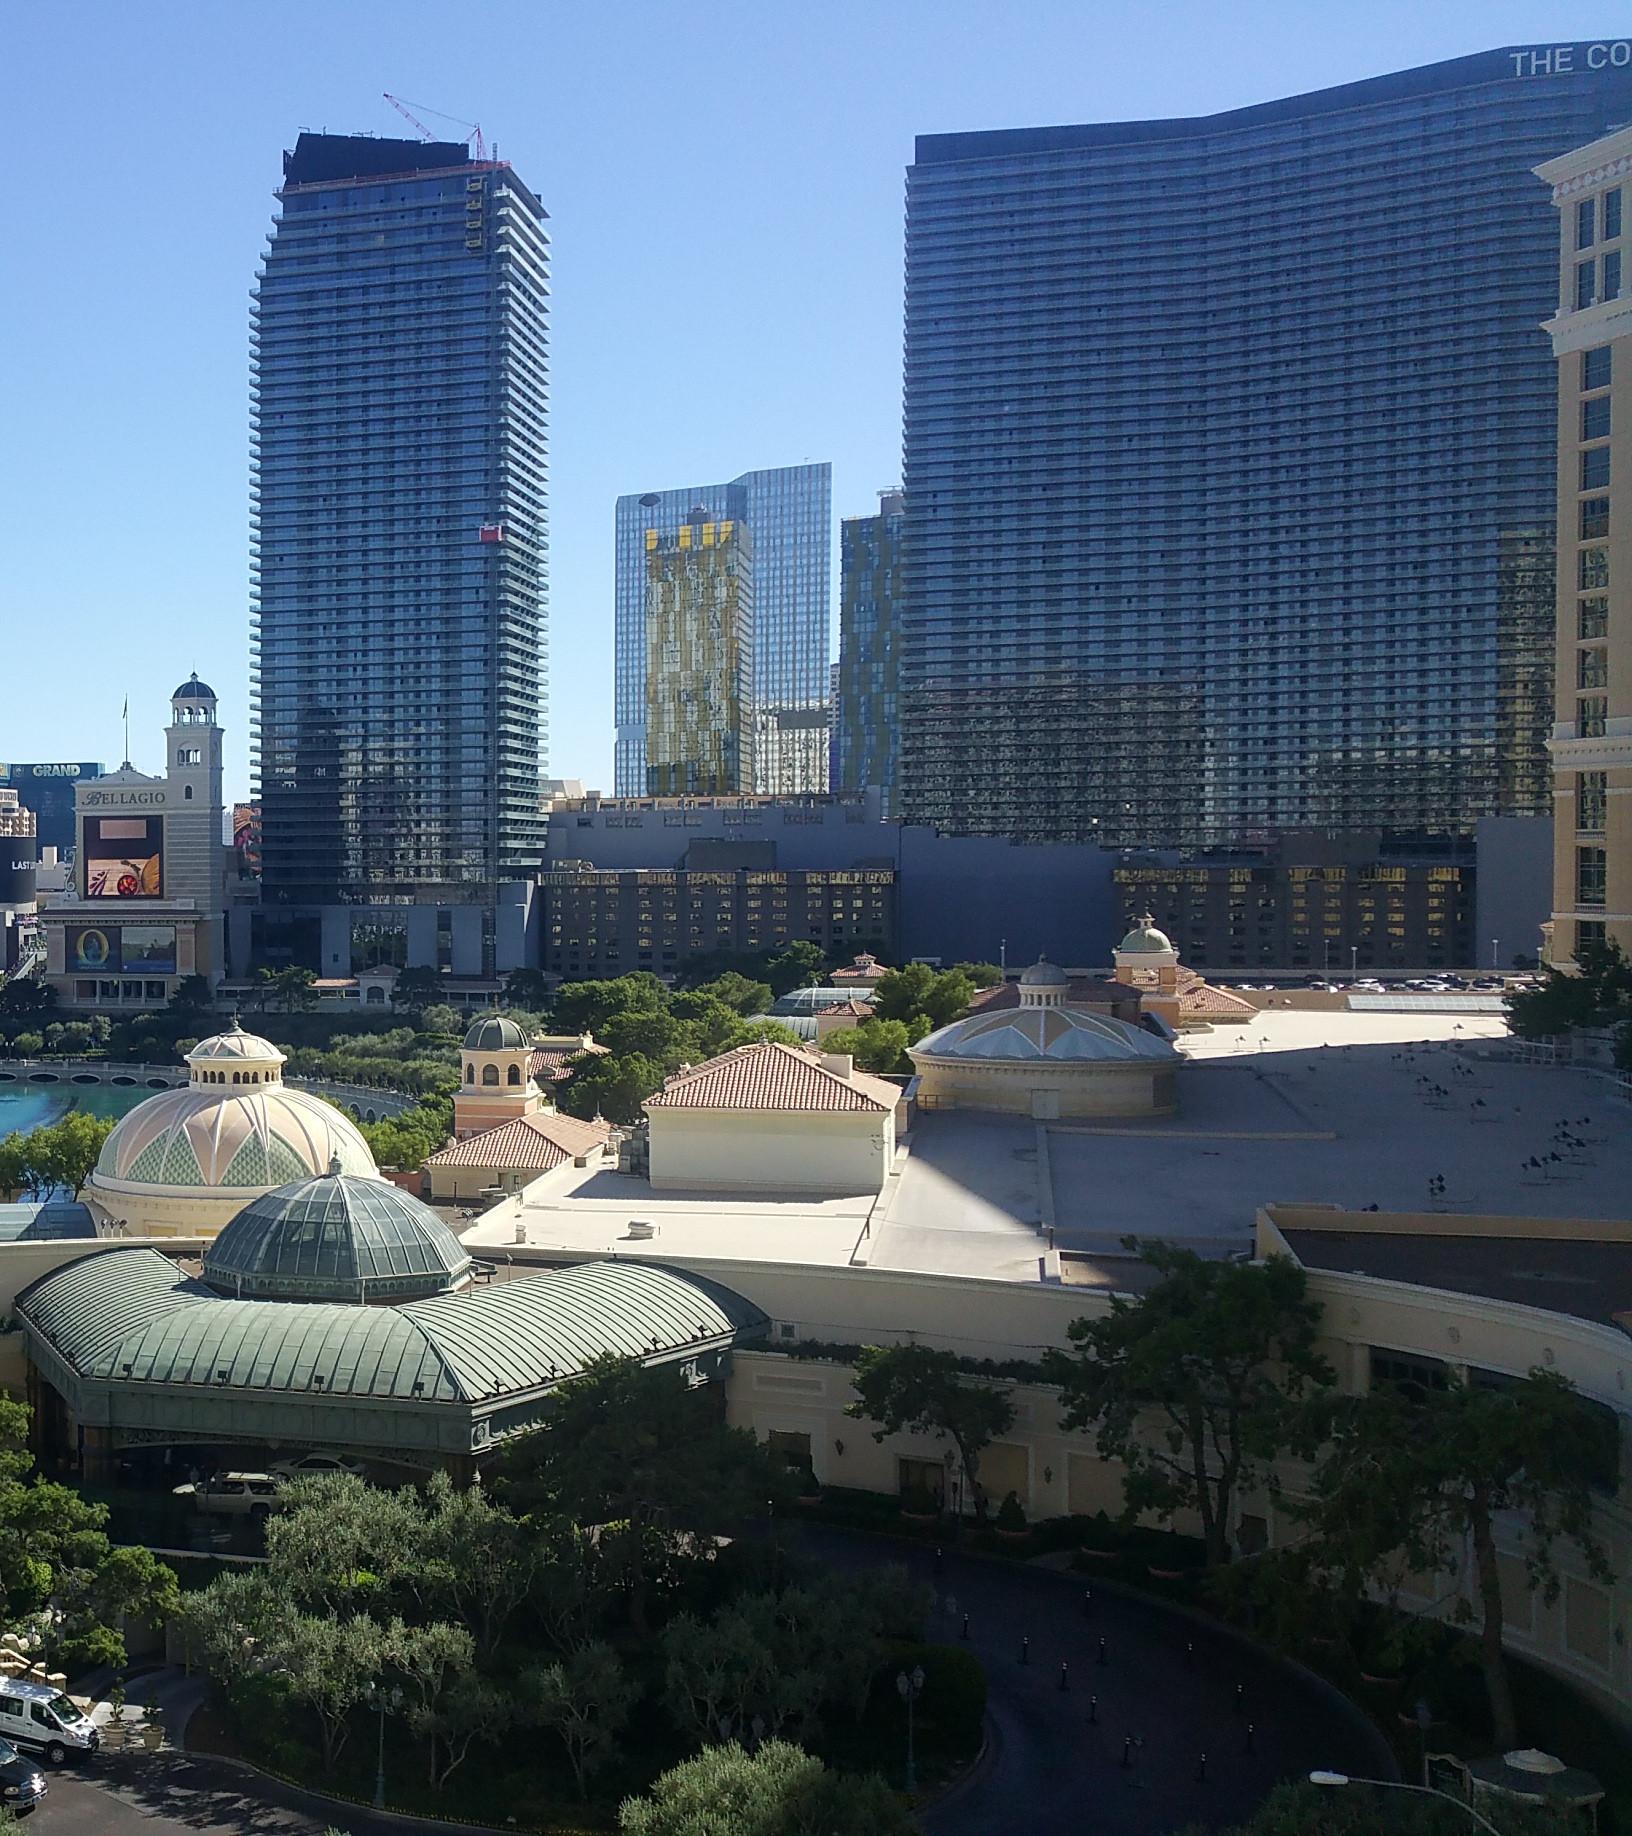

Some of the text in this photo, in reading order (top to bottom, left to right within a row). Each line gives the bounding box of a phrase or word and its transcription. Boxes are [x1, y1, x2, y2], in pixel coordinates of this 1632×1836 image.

[1509, 47, 1574, 77] THE
[32, 764, 81, 777] GRAND
[82, 791, 166, 806] BELLAGIO
